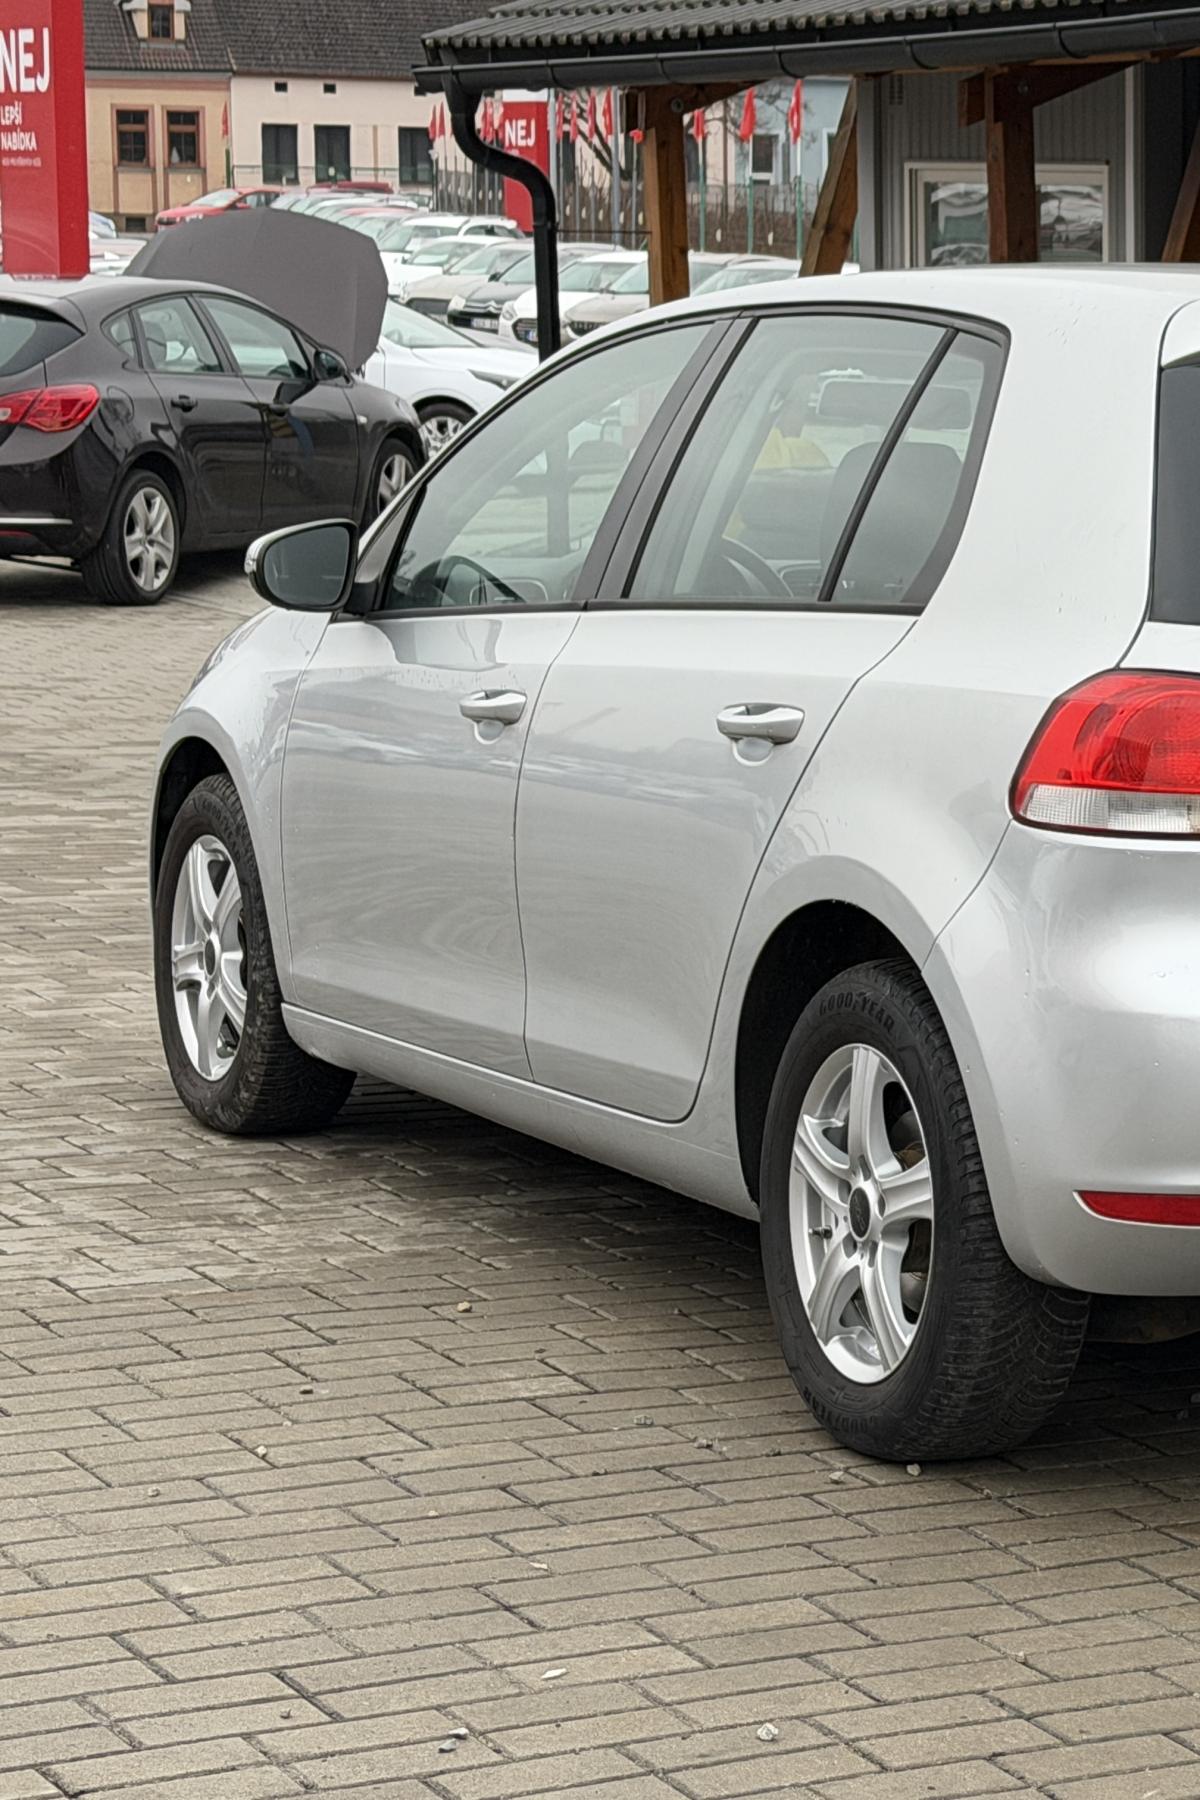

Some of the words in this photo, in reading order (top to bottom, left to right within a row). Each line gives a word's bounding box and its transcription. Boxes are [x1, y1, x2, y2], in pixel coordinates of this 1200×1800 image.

[0, 27, 50, 93] NEJ
[0, 101, 23, 125] LEPŠÍ
[0, 127, 37, 151] NABÍDKA
[504, 118, 536, 147] NEJ
